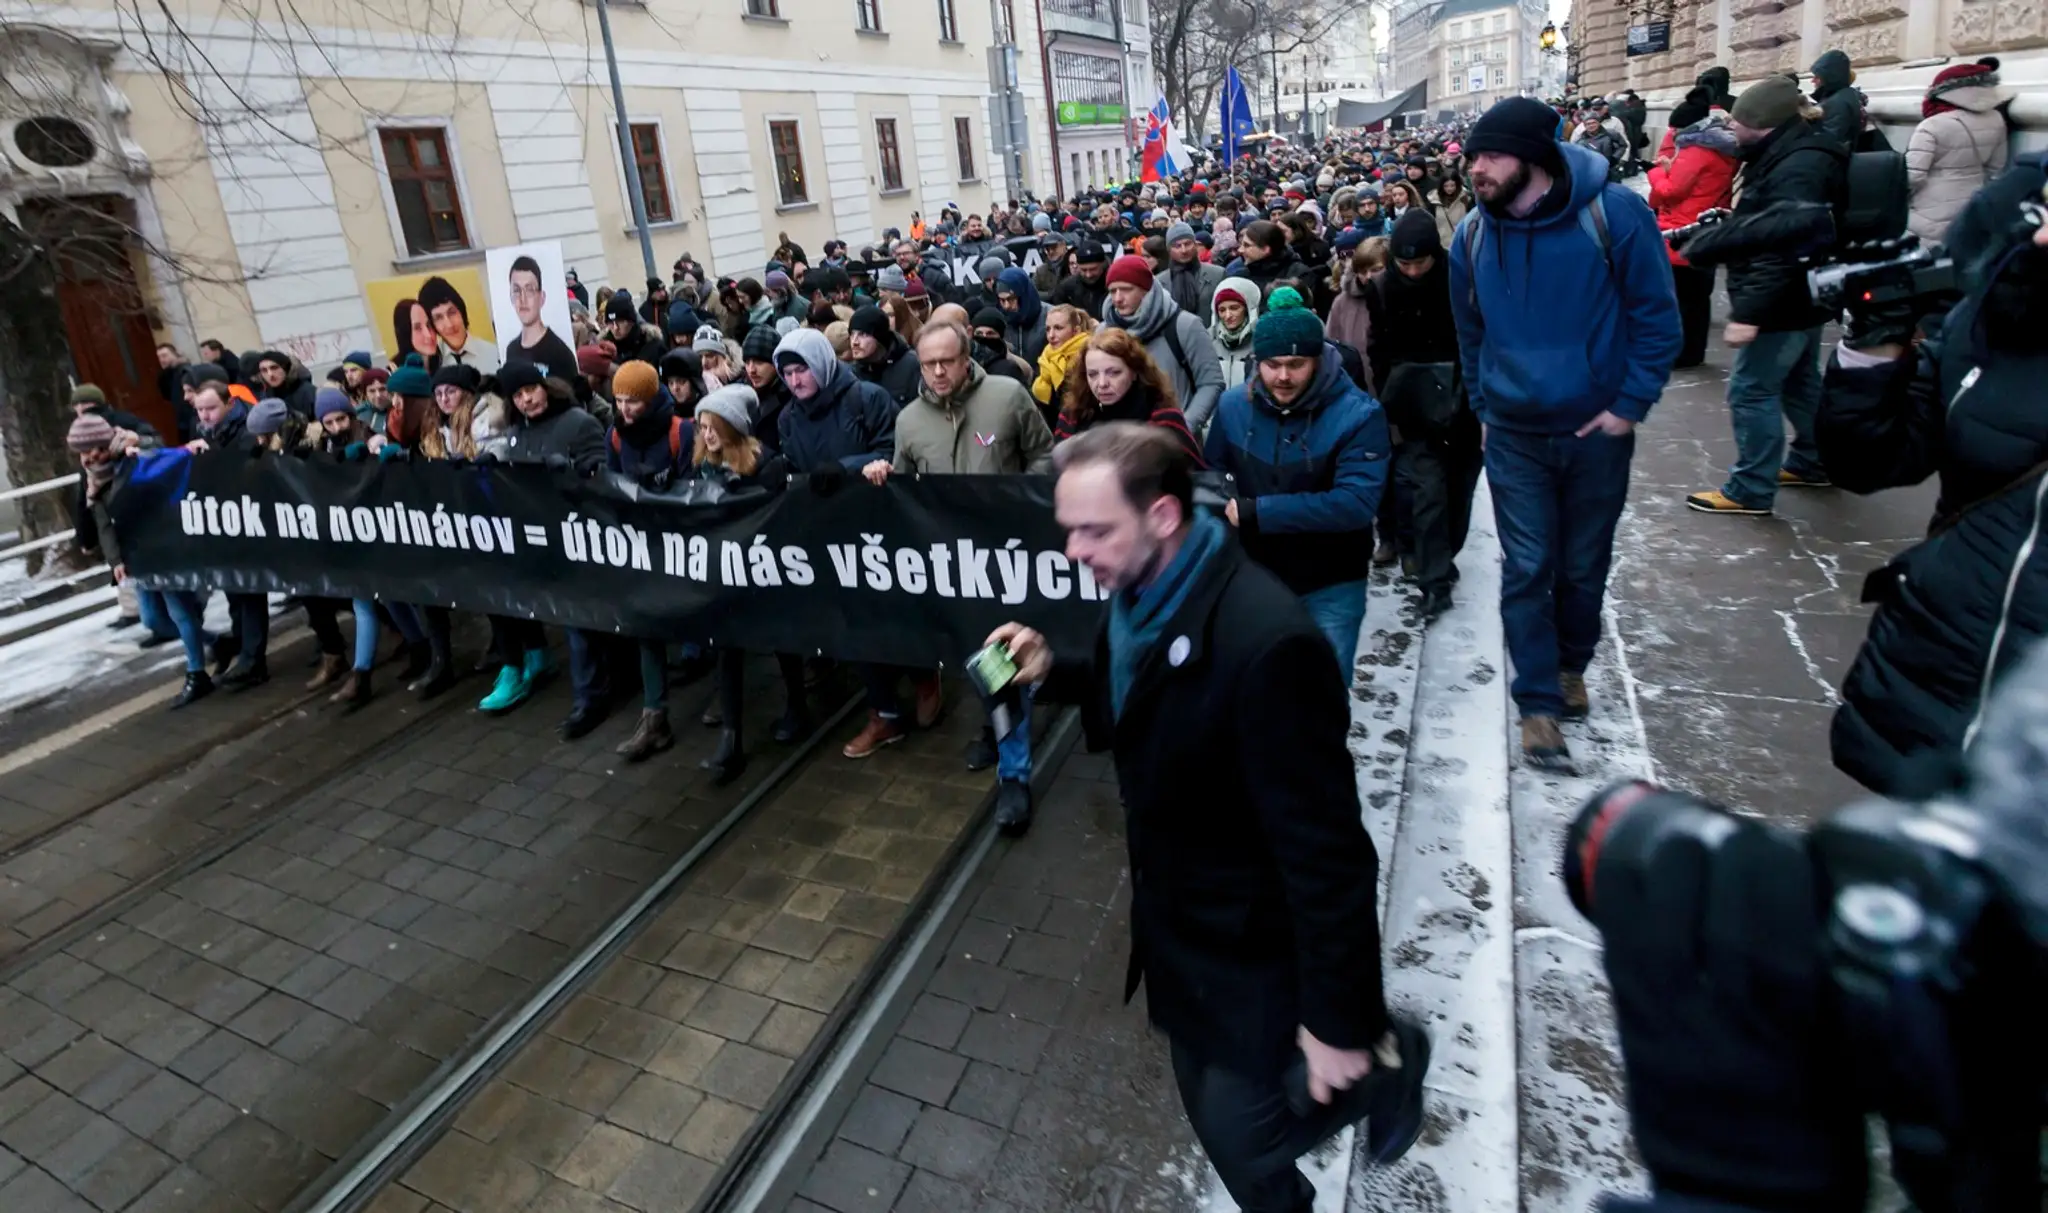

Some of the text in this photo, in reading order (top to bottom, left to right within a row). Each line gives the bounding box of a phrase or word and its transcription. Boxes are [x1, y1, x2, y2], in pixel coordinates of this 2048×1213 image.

[180, 491, 267, 537] útok
[275, 502, 319, 541] na
[329, 502, 515, 554] novinárov
[562, 511, 652, 571] útok
[662, 532, 709, 582] na
[720, 534, 815, 587] nás
